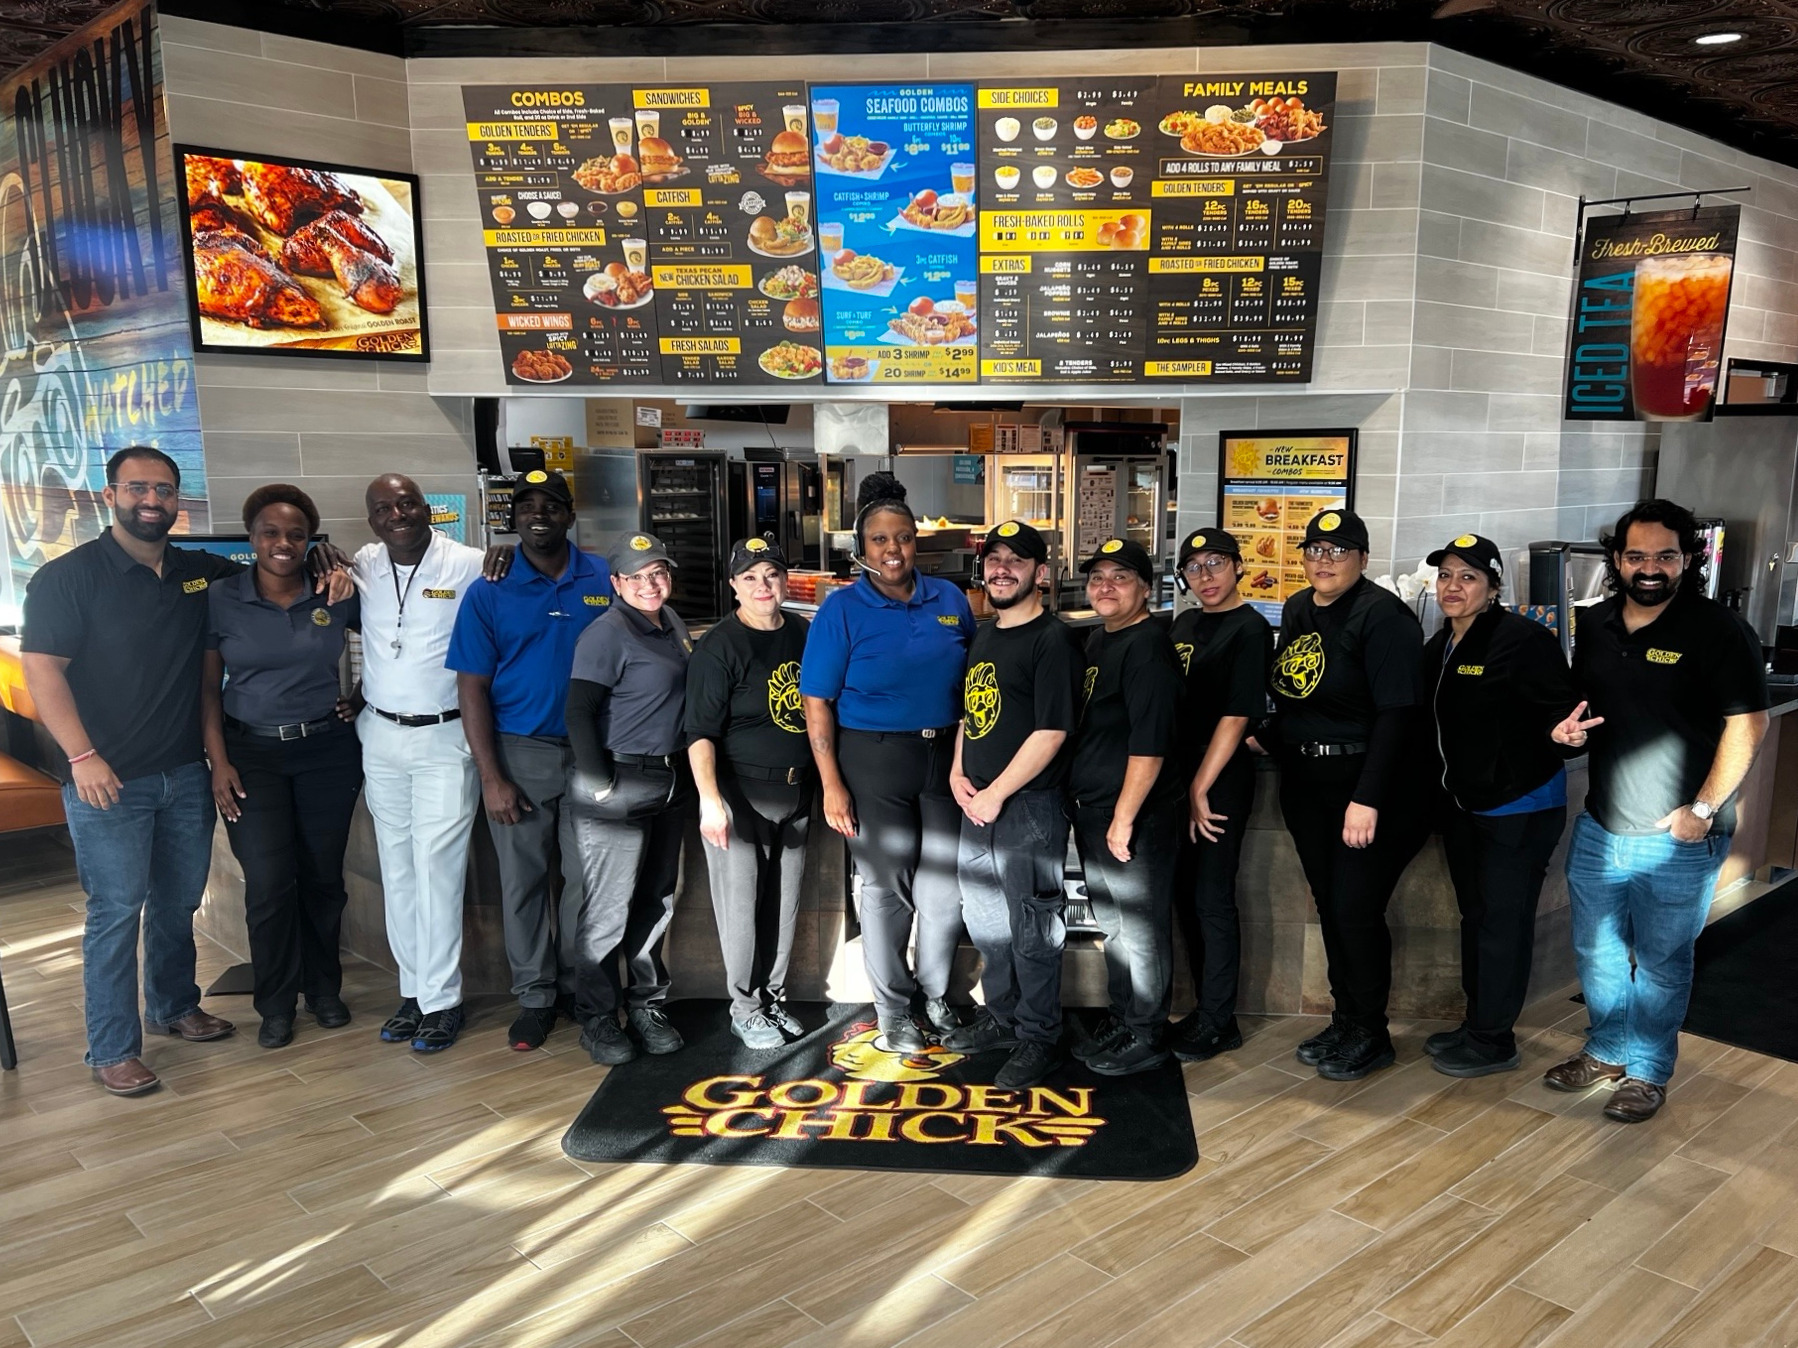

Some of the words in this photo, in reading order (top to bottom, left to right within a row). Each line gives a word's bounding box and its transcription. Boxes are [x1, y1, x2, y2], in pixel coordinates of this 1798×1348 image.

[1184, 82, 1244, 97] FAMILY
[1249, 80, 1308, 96] MEALS
[511, 91, 585, 107] COMBOS
[645, 93, 701, 104] SANDWICHES
[992, 91, 1011, 104] SIDE
[1013, 90, 1049, 103] CHOICES
[866, 98, 916, 114] SEAFOOD
[920, 97, 968, 112] COMBOS
[480, 125, 512, 137] GOLDEN
[514, 125, 552, 136] TENDERS
[904, 122, 940, 132] BUTTERFLY
[942, 122, 967, 131] SHRIMP
[1166, 162, 1181, 174] ADD
[1181, 162, 1187, 173] 4
[1188, 162, 1209, 173] ROLLS
[1211, 161, 1220, 172] TO
[1222, 160, 1235, 172] ANY
[1236, 160, 1260, 172] FAMILY
[1262, 159, 1281, 171] MEAL
[1163, 184, 1191, 193] GOLDEN
[1192, 183, 1226, 192] TENDERS
[656, 192, 690, 202] CATFISH
[834, 192, 860, 201] CATFISH
[864, 192, 889, 200] SHRIMP
[1204, 200, 1226, 210] 12PC
[1247, 200, 1268, 209] 16PC
[1287, 199, 1312, 209] 20PC
[993, 215, 1054, 228] FRESH-BAKED
[1057, 214, 1084, 226] ROLLS
[496, 231, 531, 243] ROASTED
[541, 231, 564, 242] FRIED
[566, 231, 600, 242] CHICKEN
[1592, 232, 1720, 260] Fresh-Brewed
[928, 254, 958, 264] CATFISH
[1160, 260, 1194, 269] ROASTED
[1204, 259, 1224, 268] FRIED
[1227, 259, 1259, 268] CHICKEN
[992, 260, 1025, 271] EXTRAS
[659, 273, 674, 282] NEW
[676, 274, 711, 286] CHICKEN
[713, 274, 739, 285] SALAD
[1203, 278, 1219, 287] 8PC
[1242, 278, 1262, 287] 12PC
[1283, 277, 1304, 287] 15PC
[1579, 268, 1635, 333] TEA
[366, 320, 394, 328] GOLDEN
[507, 315, 541, 327] WICKED
[542, 315, 570, 327] WINGS
[357, 332, 414, 349] GOLDEN
[561, 340, 576, 350] ZING
[671, 341, 696, 351] FRESH
[698, 340, 729, 350] SALADS
[878, 350, 891, 358] ADD
[893, 349, 902, 360] 3
[904, 350, 930, 359] SHRIMP
[993, 362, 1013, 372] KID'S
[1015, 362, 1037, 372] MEAL
[1157, 364, 1171, 372] THE
[1172, 363, 1206, 372] SAMPLER
[884, 368, 902, 378] 20
[1571, 343, 1630, 413] ICED
[86, 350, 189, 445] HATCHED
[1265, 455, 1344, 466] BREAKFAST
[1646, 648, 1683, 660] GOLDEN
[682, 1074, 1097, 1116] GOLDEN
[703, 1109, 1072, 1147] CHICK
